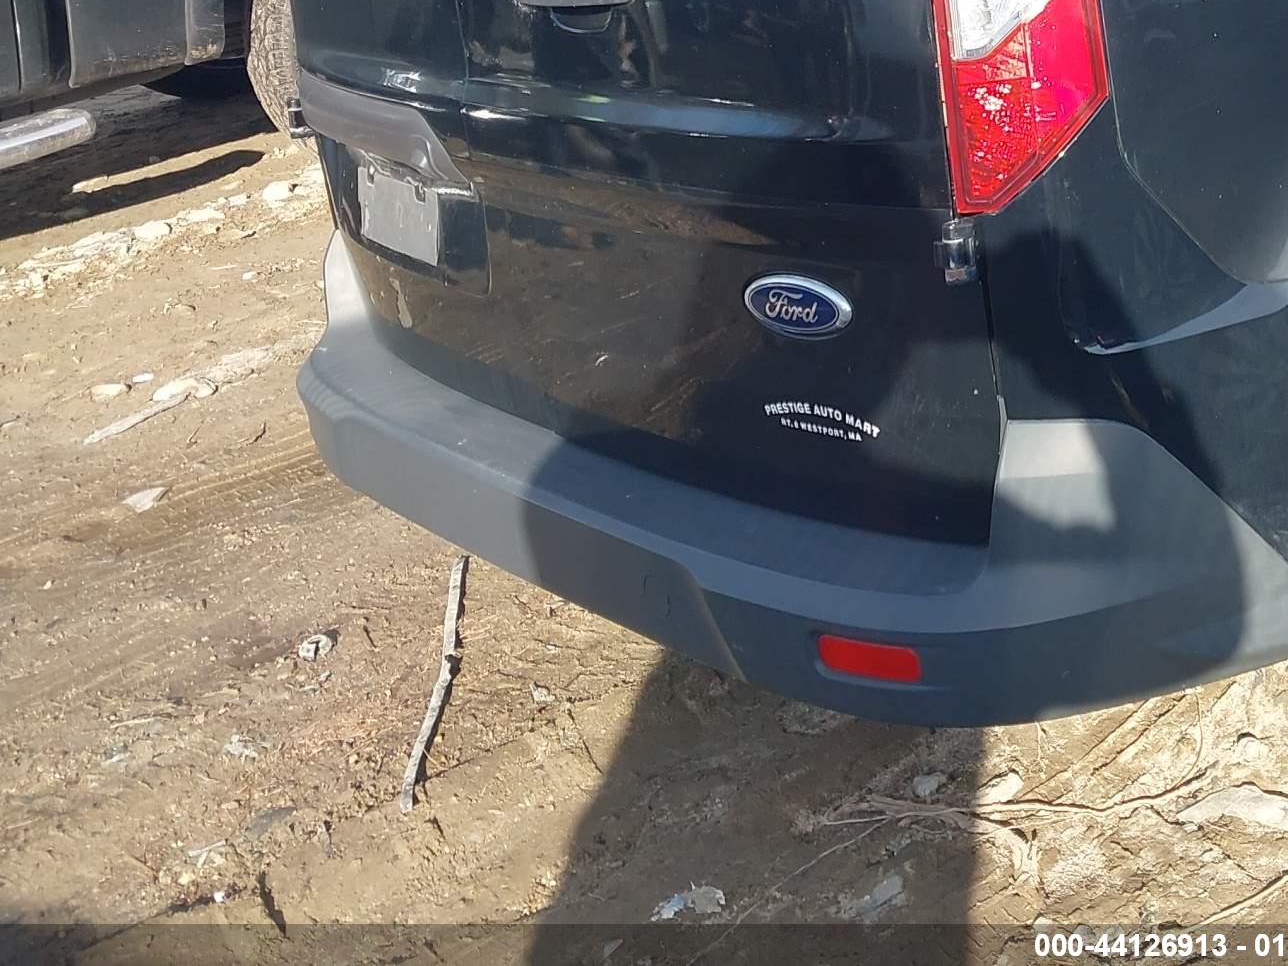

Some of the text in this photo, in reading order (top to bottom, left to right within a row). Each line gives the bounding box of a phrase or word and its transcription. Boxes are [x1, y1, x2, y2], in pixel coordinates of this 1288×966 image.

[765, 289, 819, 323] Ford
[764, 402, 881, 438] PRESTIGE AUTO MART
[848, 431, 863, 442] MA
